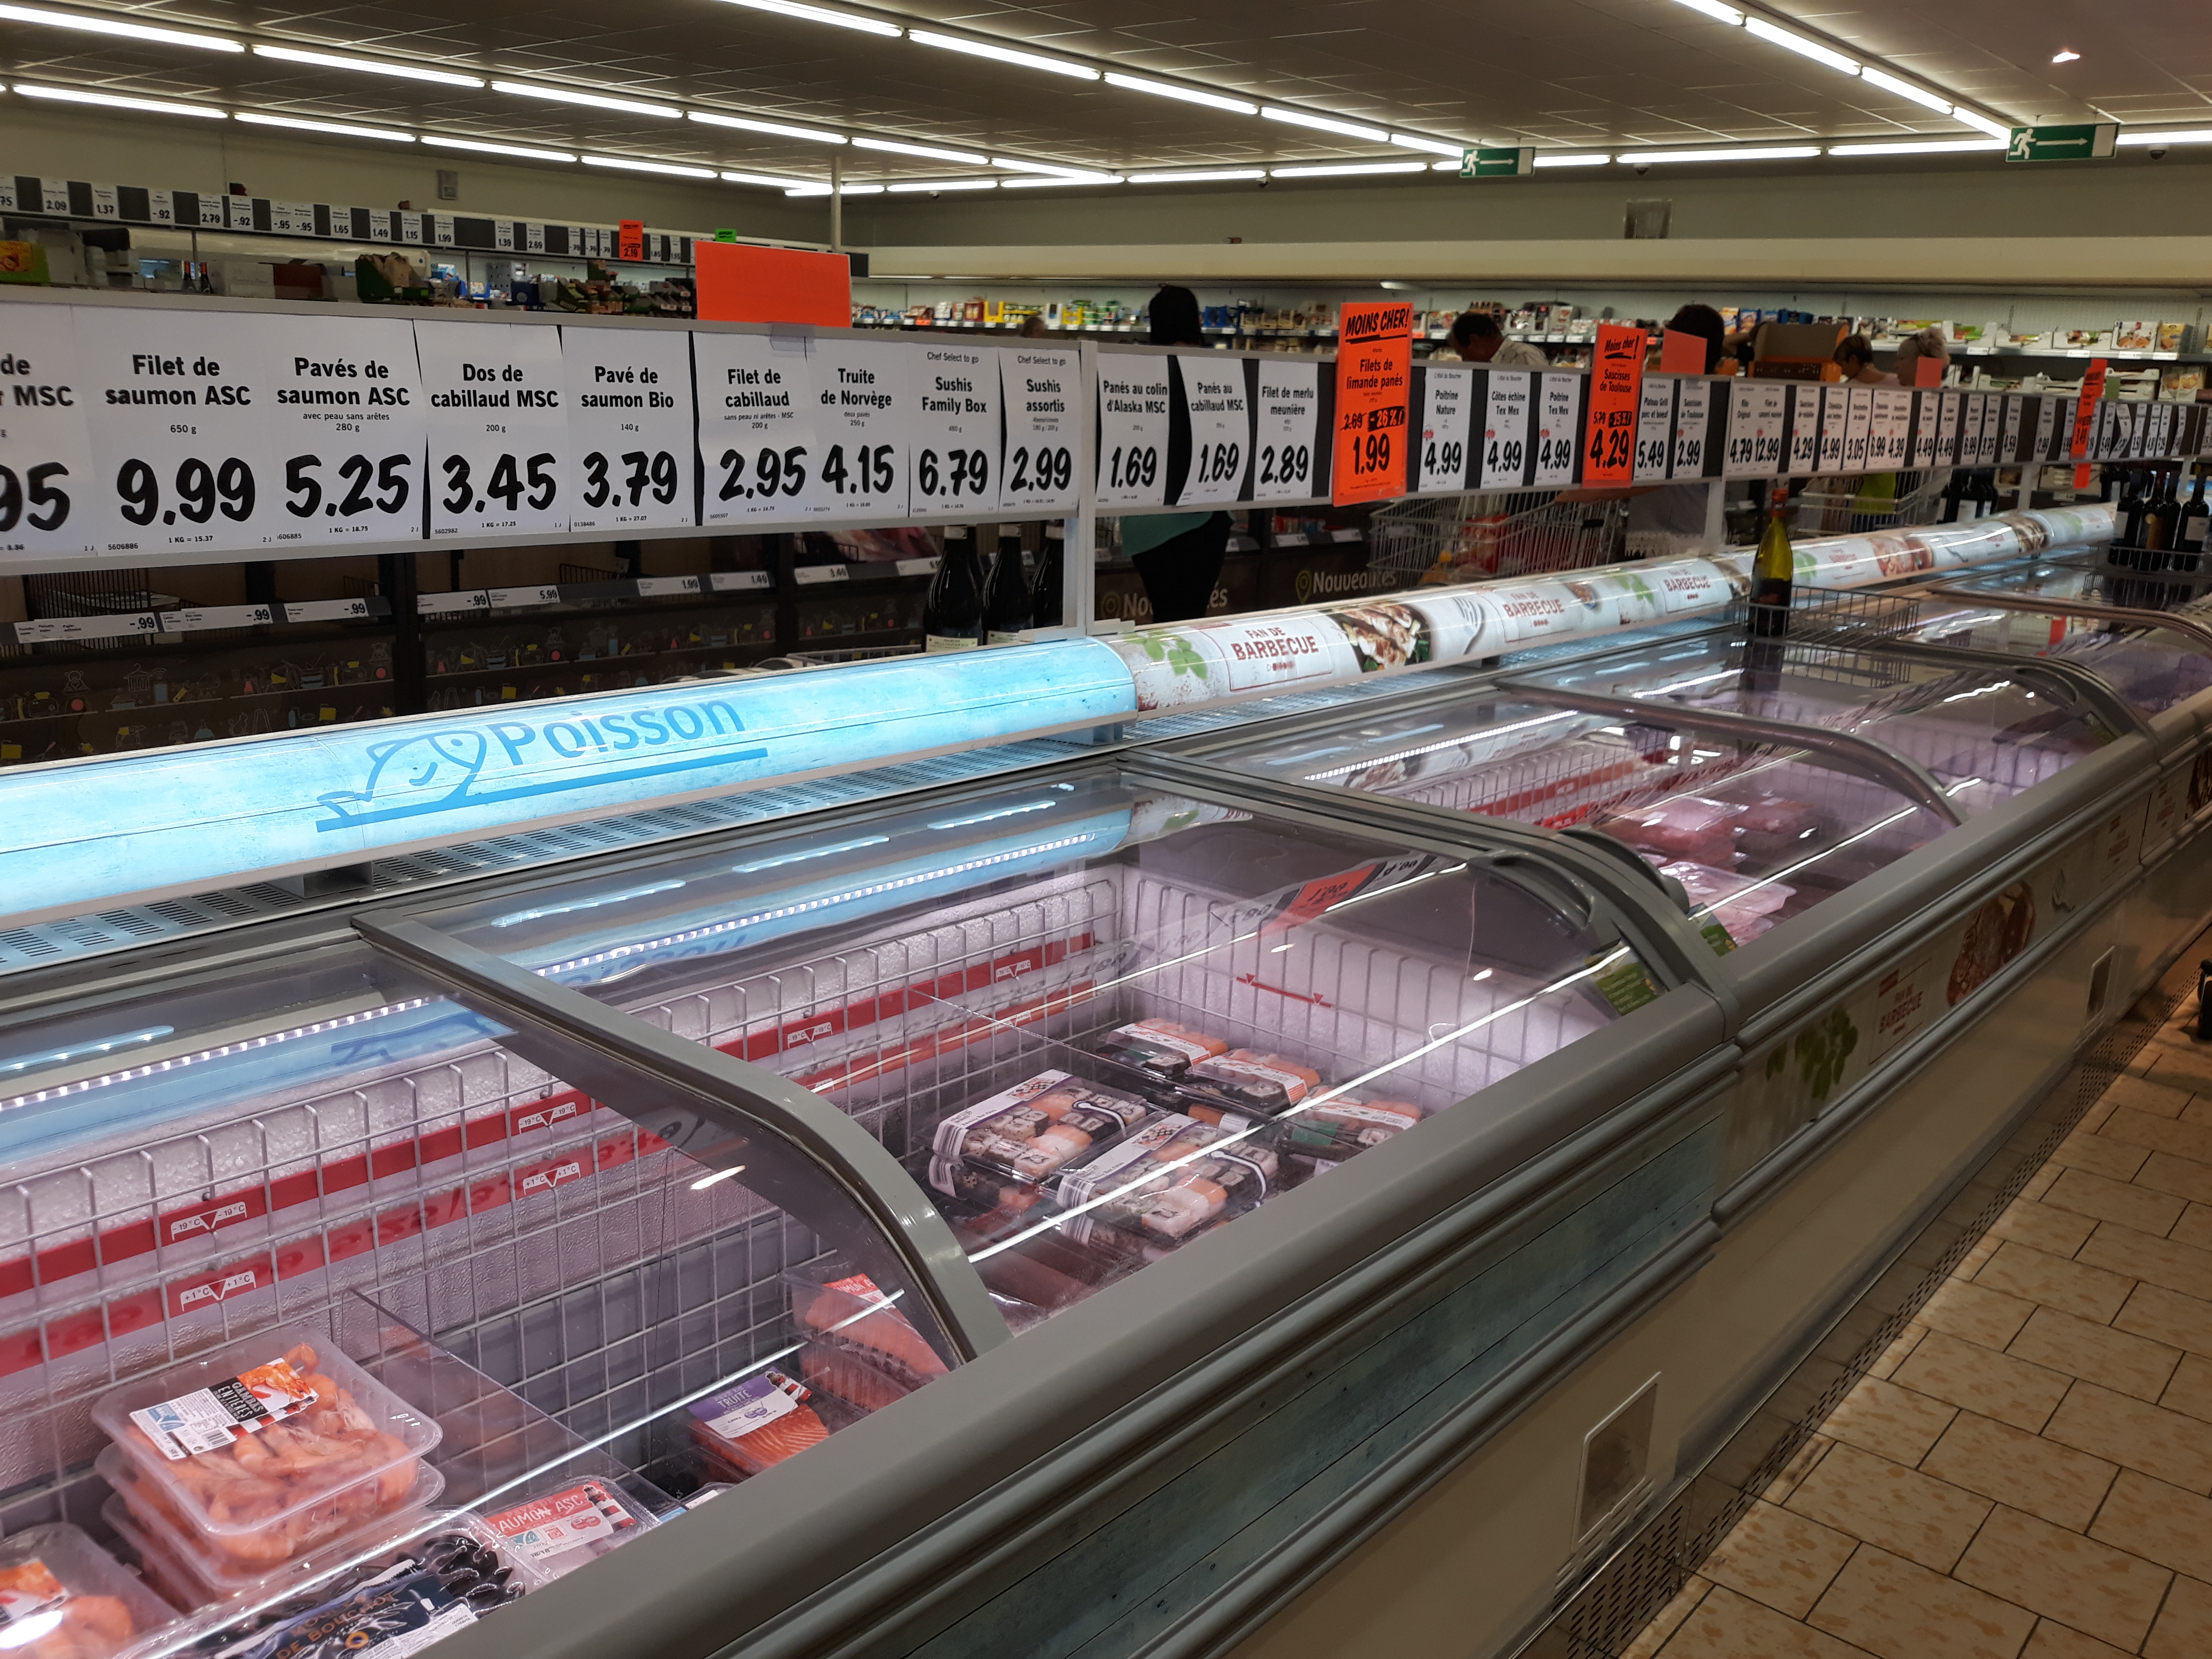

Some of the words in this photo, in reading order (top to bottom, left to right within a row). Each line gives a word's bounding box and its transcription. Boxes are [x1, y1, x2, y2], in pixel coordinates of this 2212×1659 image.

[1345, 312, 1378, 337] MOINS
[1381, 308, 1409, 331] CHER!
[1, 354, 30, 375] de
[132, 355, 185, 375] Filet
[193, 356, 220, 376] de
[927, 352, 941, 361] Chef
[944, 353, 962, 362] Select
[1033, 356, 1051, 364] Select
[1360, 359, 1381, 372] Filets
[1384, 357, 1392, 370] de
[295, 357, 357, 377] Pavés
[364, 360, 388, 378] de
[463, 363, 496, 382] Dos
[502, 364, 523, 382] de
[595, 366, 634, 383] Pavé
[640, 367, 658, 384] de
[728, 369, 760, 384] Filet
[764, 369, 781, 384] de
[838, 368, 875, 384] Truite
[936, 377, 973, 392] Sushis
[1026, 379, 1061, 393] Sushis
[1103, 380, 1130, 394] Panés
[1132, 385, 1143, 394] au
[1146, 383, 1168, 395] colin
[1197, 382, 1221, 394] Panés
[1223, 385, 1232, 394] au
[1347, 375, 1378, 390] limande
[1381, 373, 1403, 390] panés
[13, 385, 73, 406] MSC
[105, 389, 196, 405] saumon
[205, 386, 251, 405] ASC
[277, 390, 360, 405] saumon
[368, 387, 410, 406] ASC
[431, 390, 510, 407] cabillaud
[517, 390, 559, 407] MSC
[581, 394, 643, 407] saumon
[649, 391, 674, 408] Bio
[726, 391, 790, 407] cabillaud
[821, 390, 836, 405] de
[841, 390, 892, 409] Norvège
[1262, 386, 1279, 398] Filet
[1281, 387, 1290, 398] de
[1293, 387, 1313, 399] merlu
[922, 397, 961, 415] Family
[965, 398, 987, 413] Box
[1027, 399, 1065, 412] assortis
[1107, 399, 1142, 413] d'Alaska
[1145, 401, 1165, 414] MSC
[1191, 399, 1225, 412] cabillaud
[1227, 399, 1244, 411] MSC
[1271, 404, 1305, 415] meunière
[367, 412, 390, 420] arêtes
[170, 424, 188, 433] 650
[191, 427, 197, 435] g
[1353, 432, 1389, 475] 1.99
[1488, 440, 1521, 472] 4.99
[1541, 439, 1571, 469] 4.99
[1590, 429, 1629, 468] 4.29
[1638, 440, 1664, 468] 5.49
[1677, 440, 1700, 467] 2.99
[1730, 438, 1752, 463] 4.79
[1111, 446, 1156, 488] 1.69
[1199, 443, 1239, 483] 1.69
[1260, 445, 1308, 484] 2.89
[1424, 442, 1461, 475] 4.99
[584, 451, 677, 507] 3.79
[719, 446, 807, 501] 2.95
[821, 445, 894, 494] 4.15
[920, 449, 988, 496] 6.79
[1011, 447, 1071, 492] 2.99
[117, 458, 255, 526] 9.99
[286, 454, 411, 518] 5.25
[443, 453, 556, 514] 3.45
[1502, 598, 1566, 617] BARBECUE
[1270, 627, 1284, 636] DE
[1230, 636, 1319, 660] BARBECUE
[488, 699, 745, 765] Poisson
[232, 1381, 264, 1413] GAMBAS
[717, 1389, 752, 1409] TRUITE
[555, 1495, 583, 1513] ASC
